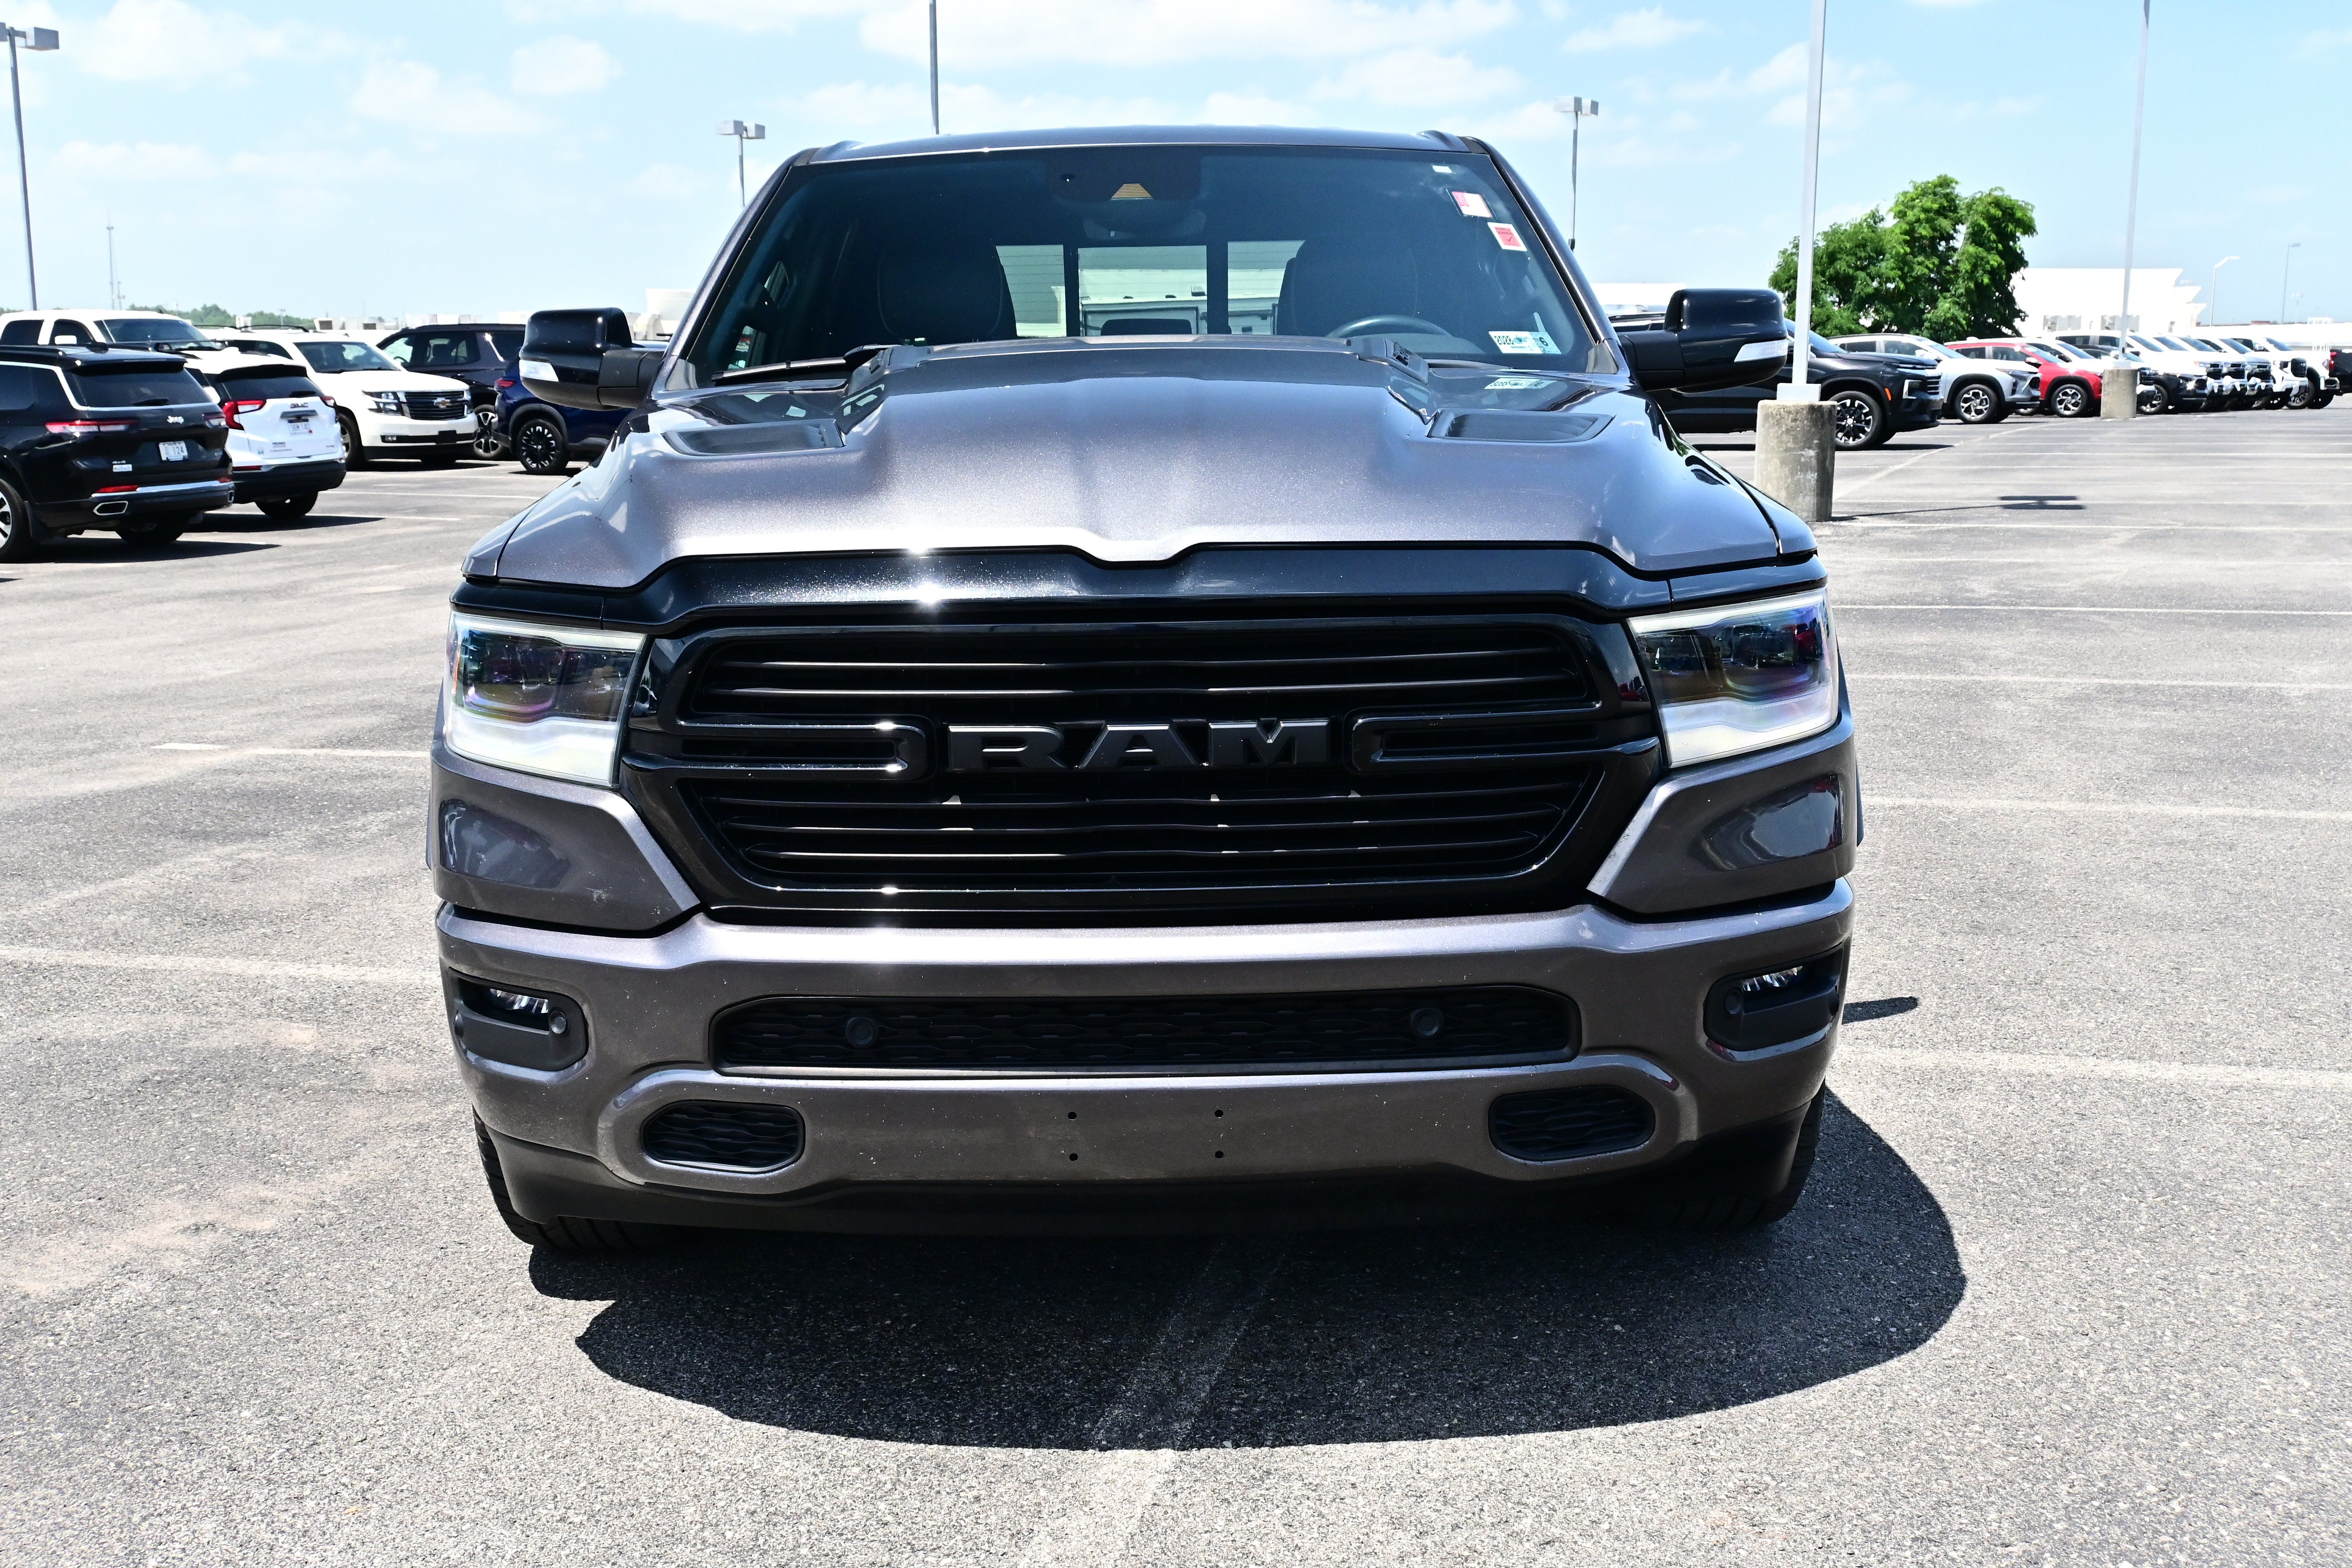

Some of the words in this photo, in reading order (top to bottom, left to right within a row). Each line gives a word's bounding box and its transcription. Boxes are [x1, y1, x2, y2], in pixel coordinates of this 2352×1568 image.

[1494, 335, 1514, 345] 2028
[1539, 337, 1549, 346] 6
[166, 416, 184, 424] Jeep
[946, 718, 1331, 770] RAM
